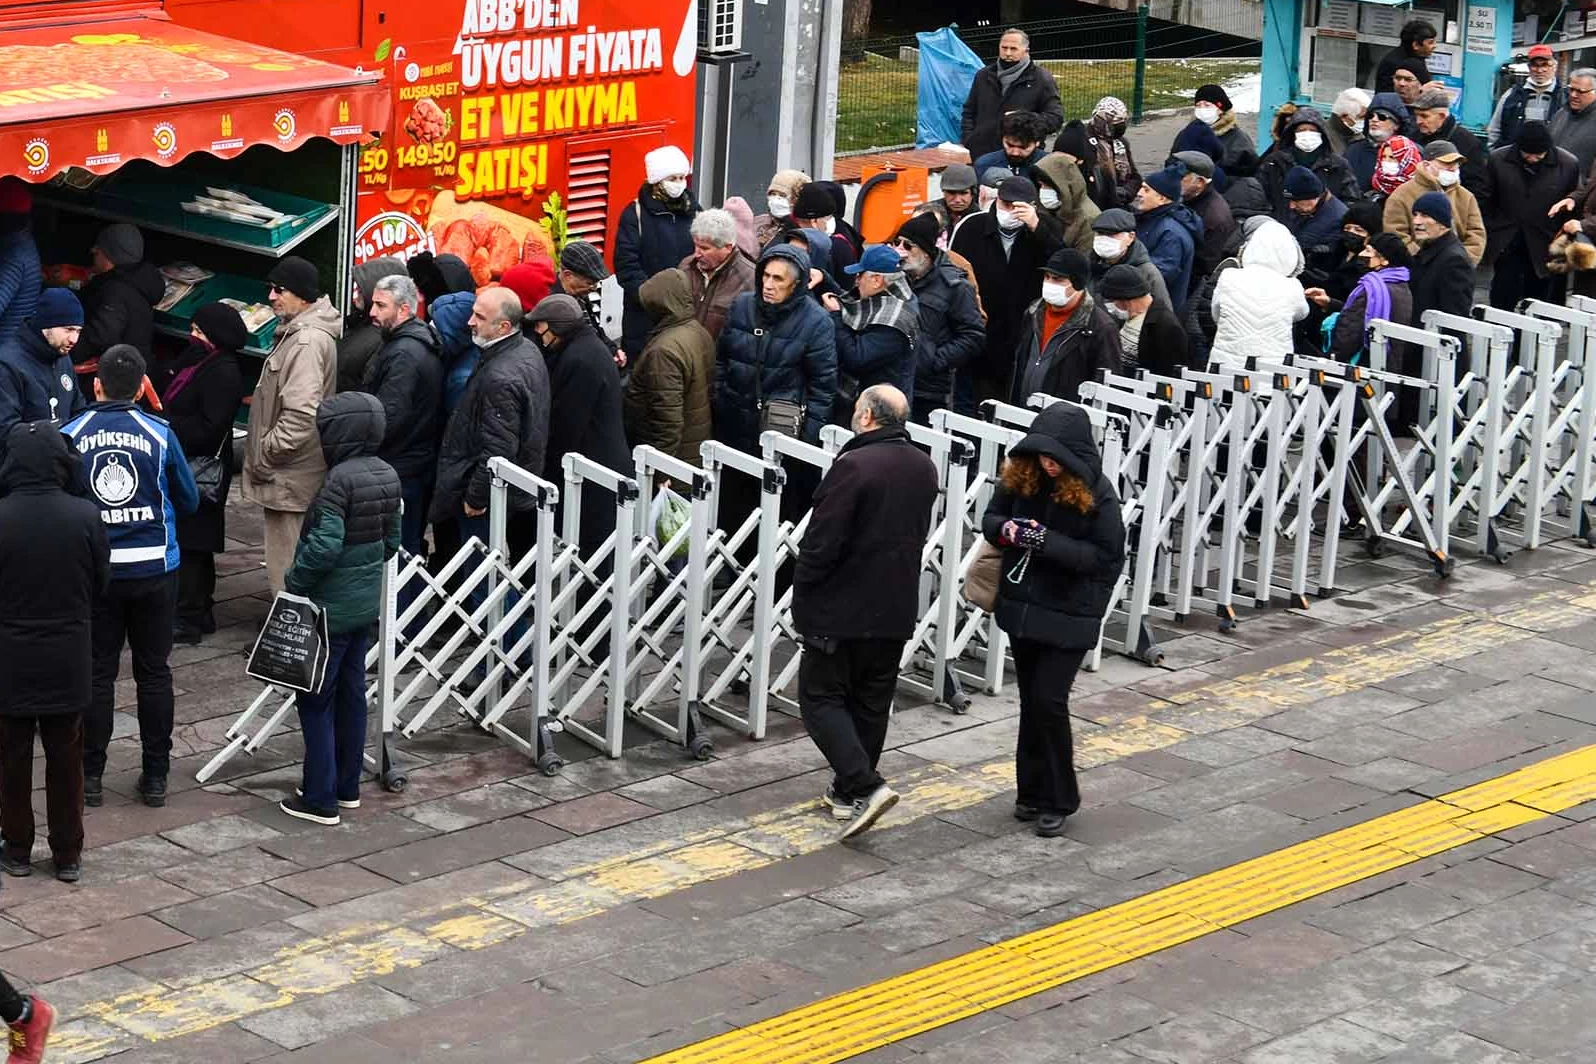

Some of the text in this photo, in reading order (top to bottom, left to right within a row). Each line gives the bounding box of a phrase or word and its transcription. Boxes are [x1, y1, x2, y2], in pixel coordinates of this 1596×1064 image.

[461, 25, 663, 87] UYGUN FİYATA
[399, 82, 459, 100] KUŞBAŞI ET
[460, 82, 638, 141] ET VE KIYMA
[358, 148, 388, 173] .50
[396, 141, 456, 169] 149.50
[455, 144, 548, 198] SATIŞI
[355, 221, 408, 262] %100
[76, 429, 153, 457] ÜYÜKŞEHİR
[101, 506, 155, 524] ABITA
